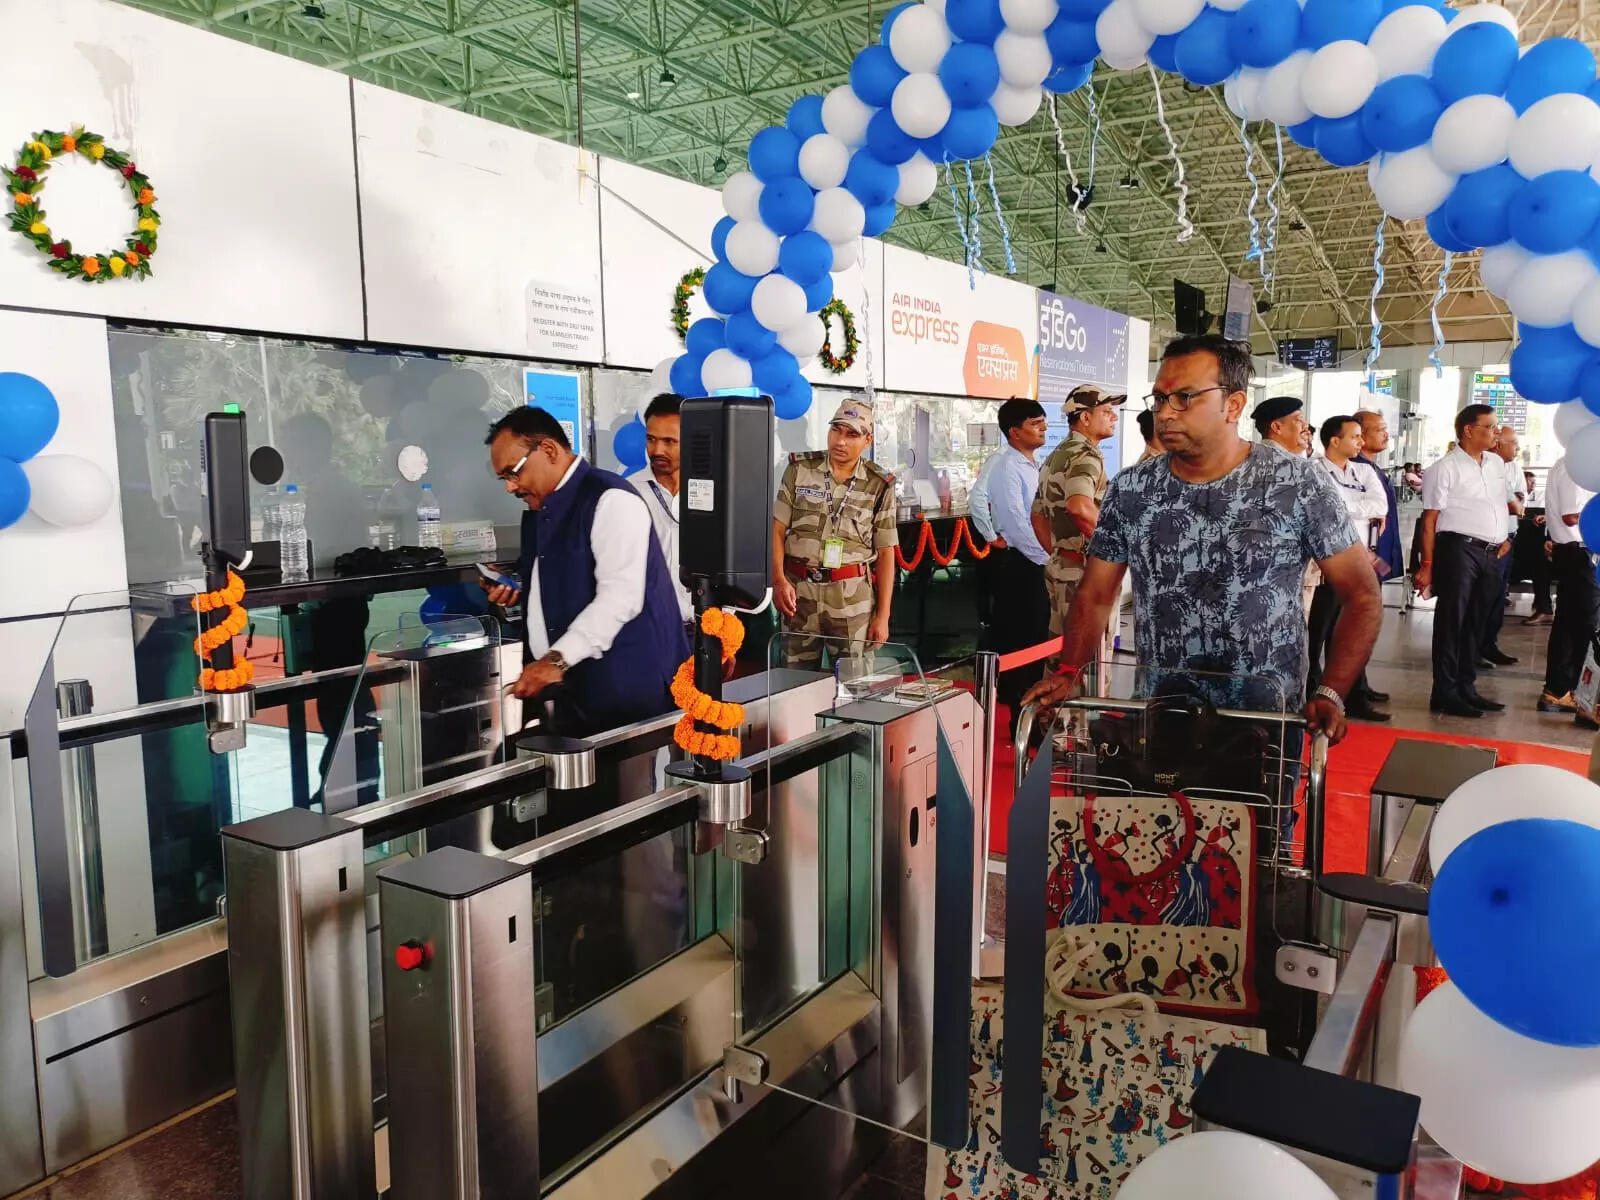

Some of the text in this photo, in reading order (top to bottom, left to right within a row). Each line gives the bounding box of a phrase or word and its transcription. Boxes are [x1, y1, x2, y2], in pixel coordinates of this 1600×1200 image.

[892, 292, 942, 315] AIR INDIA
[533, 317, 556, 326] REGISTER
[556, 320, 569, 328] WITH
[891, 309, 960, 345] express
[539, 328, 589, 342] FOR SEAMLESS TRAVEL
[552, 341, 579, 350] EXPERIENCE
[976, 352, 1018, 383] एक्सप्रेस
